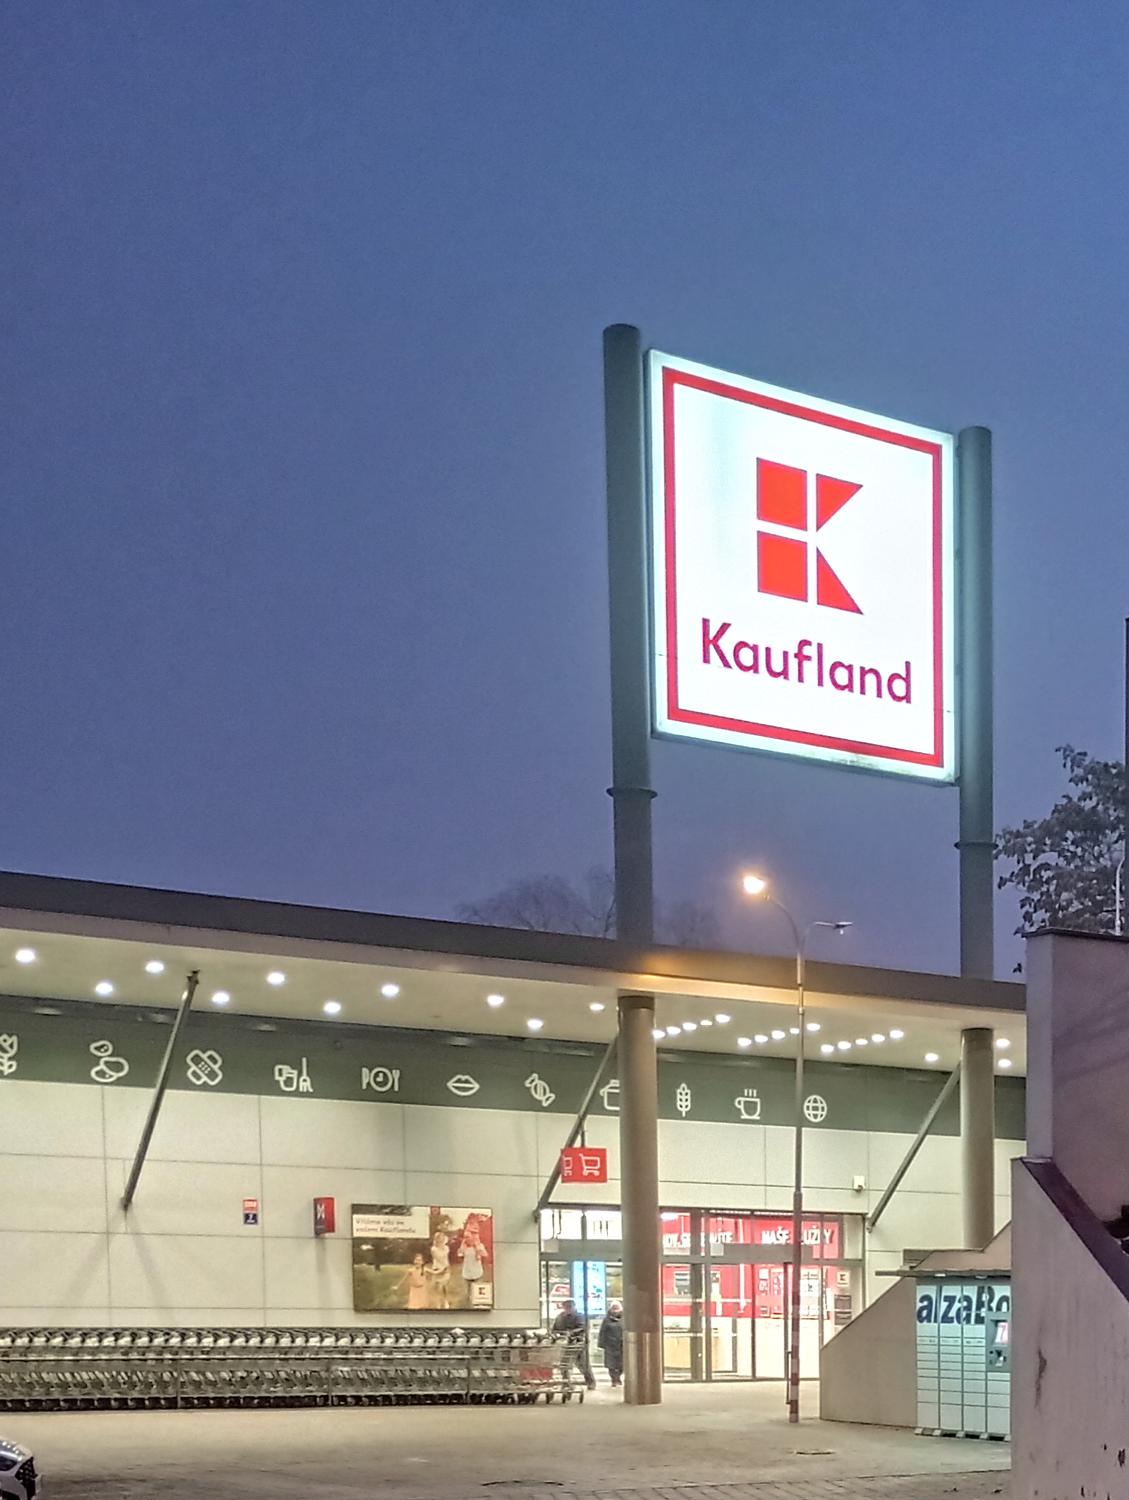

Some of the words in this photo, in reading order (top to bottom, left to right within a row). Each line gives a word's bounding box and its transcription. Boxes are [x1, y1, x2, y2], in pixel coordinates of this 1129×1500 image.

[756, 456, 864, 615] K
[702, 617, 912, 704] Kaufland
[761, 1226, 790, 1244] NAŠE
[917, 1286, 1010, 1324] alzaBo
